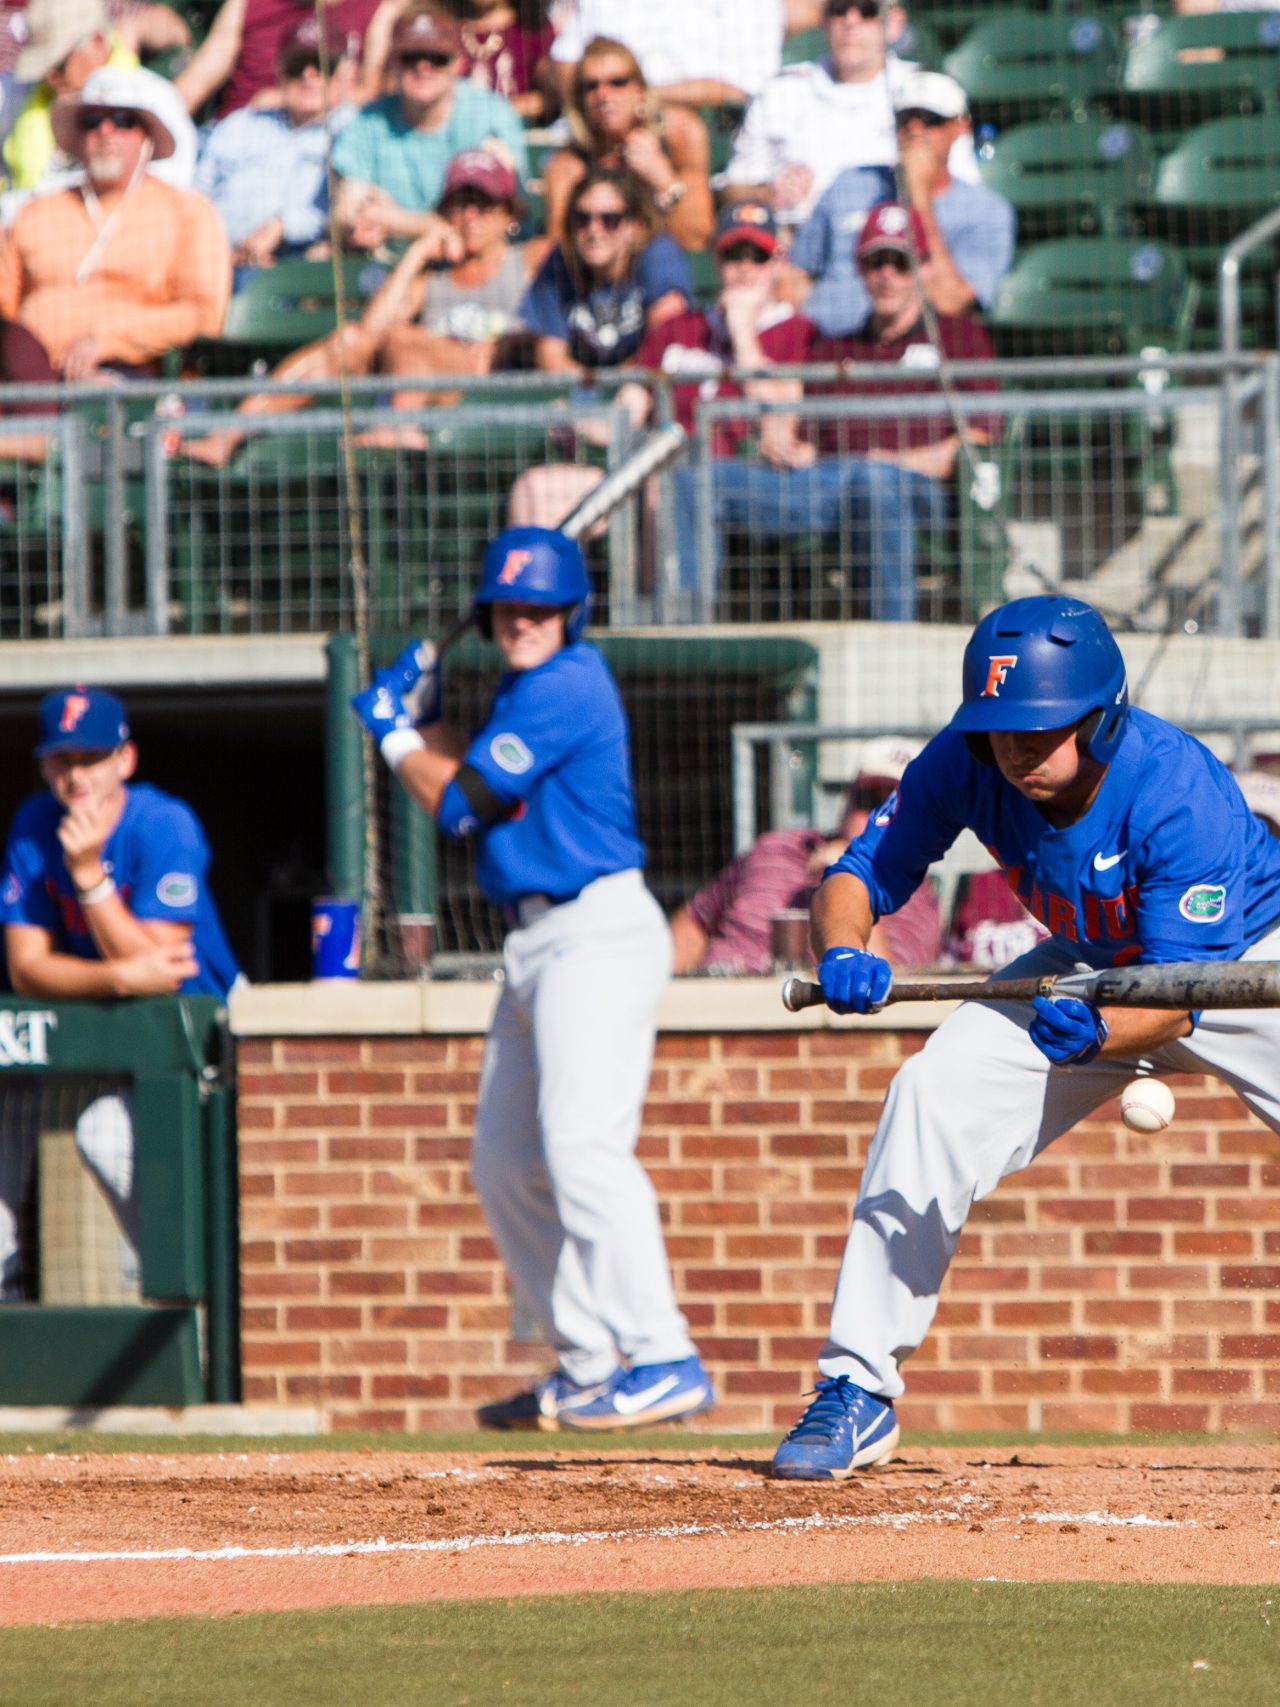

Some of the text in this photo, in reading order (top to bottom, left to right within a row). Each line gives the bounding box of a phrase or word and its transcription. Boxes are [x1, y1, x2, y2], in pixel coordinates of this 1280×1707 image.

[497, 549, 532, 585] F
[980, 655, 1017, 697] F
[59, 694, 89, 733] F
